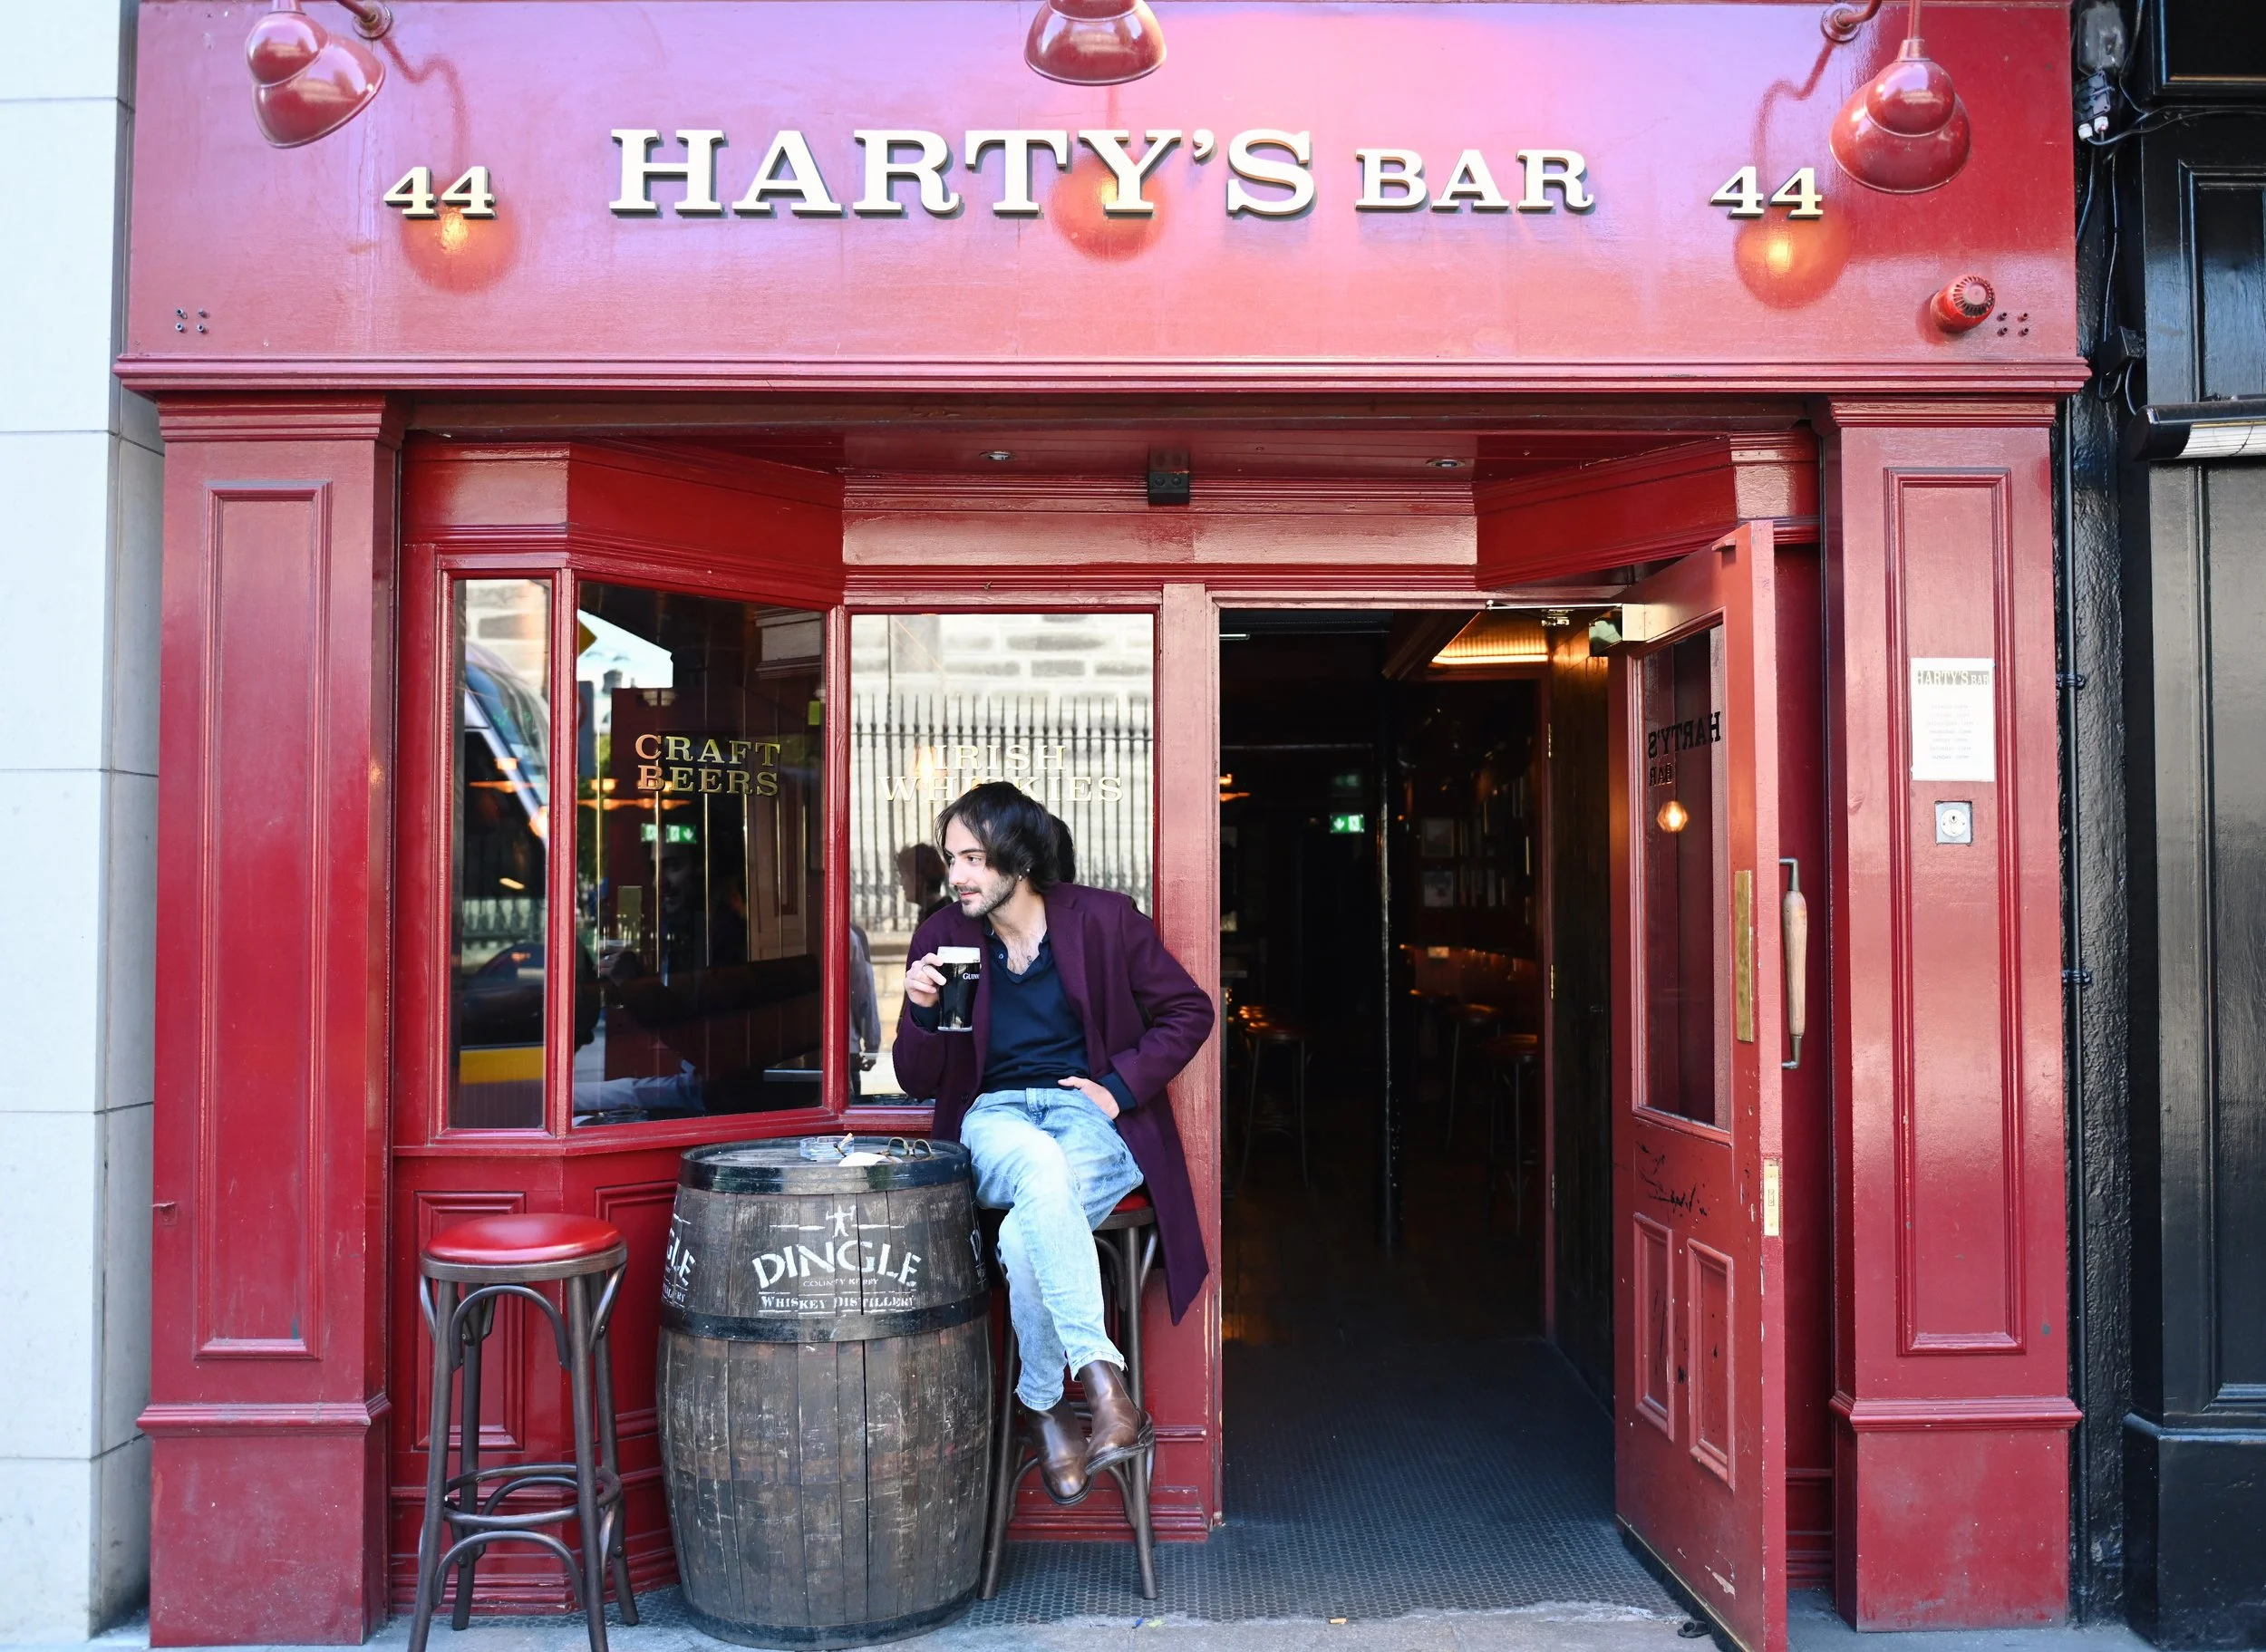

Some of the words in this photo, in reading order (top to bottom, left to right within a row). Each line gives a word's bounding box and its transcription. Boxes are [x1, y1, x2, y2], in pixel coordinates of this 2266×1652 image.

[609, 128, 1315, 216] HARTY'S
[1355, 149, 1594, 211] BAR
[383, 166, 496, 218] 44
[1709, 166, 1824, 218] 44
[634, 733, 781, 767] CRAFT
[933, 744, 1067, 770] IRISH
[637, 764, 780, 797] BEERS
[876, 776, 1124, 803] WHIKIES
[751, 1240, 922, 1289] DINGLE
[803, 1279, 846, 1287] COUNTY
[760, 1295, 828, 1309] WHISKEY
